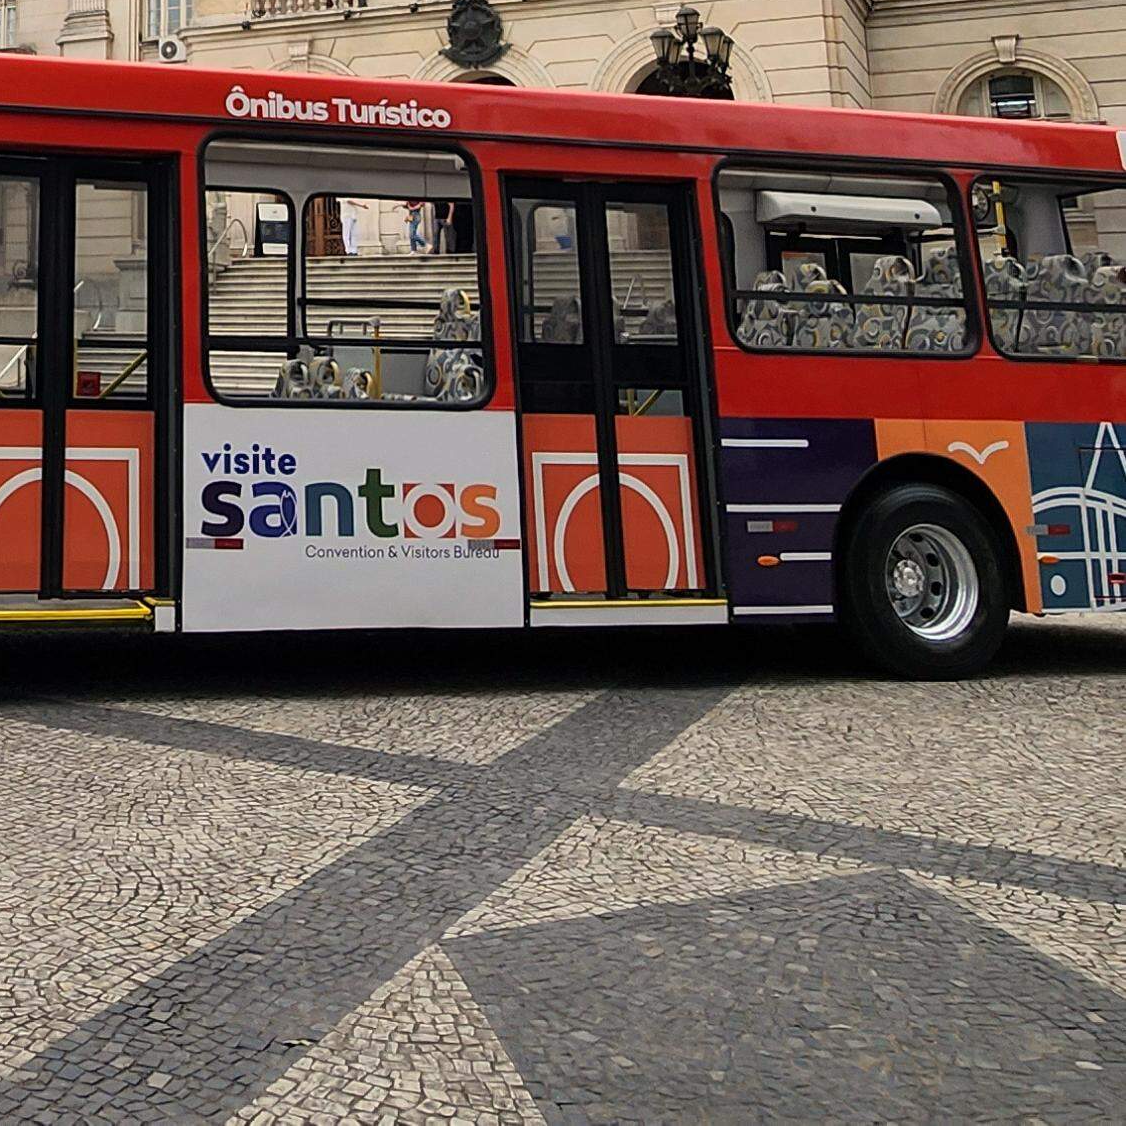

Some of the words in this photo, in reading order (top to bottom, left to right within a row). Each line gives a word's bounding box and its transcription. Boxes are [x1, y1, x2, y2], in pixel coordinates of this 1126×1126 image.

[225, 85, 329, 121] Ônibus
[331, 97, 451, 128] Turístico
[201, 443, 297, 475] visite
[200, 468, 501, 539] santos
[305, 545, 384, 559] Convention
[388, 546, 398, 559] &
[401, 546, 451, 559] Visitors
[454, 546, 500, 559] Bureau
